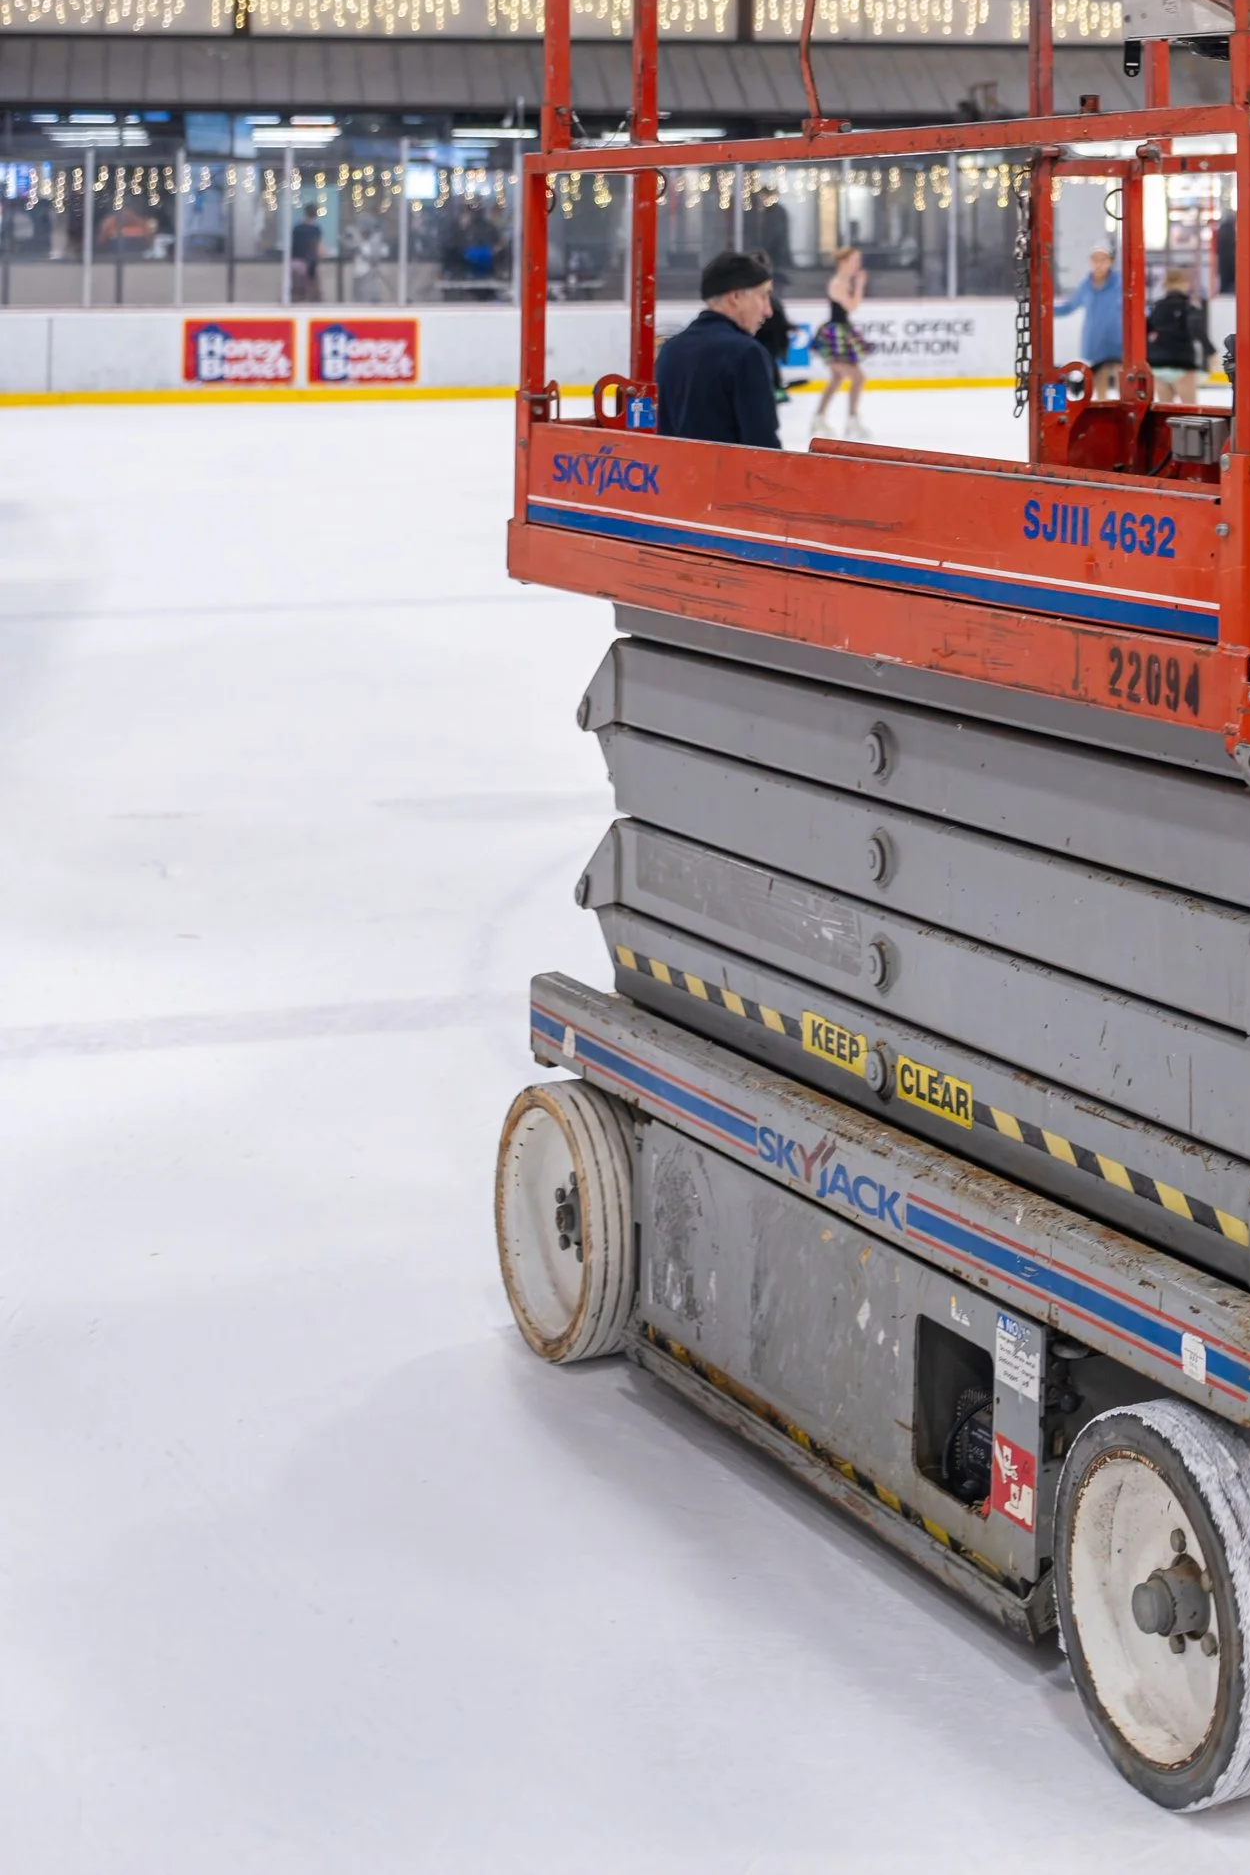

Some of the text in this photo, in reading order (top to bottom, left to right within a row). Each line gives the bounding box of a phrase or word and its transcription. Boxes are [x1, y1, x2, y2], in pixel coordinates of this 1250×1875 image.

[869, 340, 960, 355] OMATION
[904, 320, 974, 337] OFFICE
[552, 445, 660, 496] SKYJACK
[1023, 499, 1177, 559] SJIII 4632
[1107, 645, 1200, 718] 22094
[811, 1019, 970, 1121] KEEP CLEAR
[758, 1126, 903, 1231] SKYJACK
